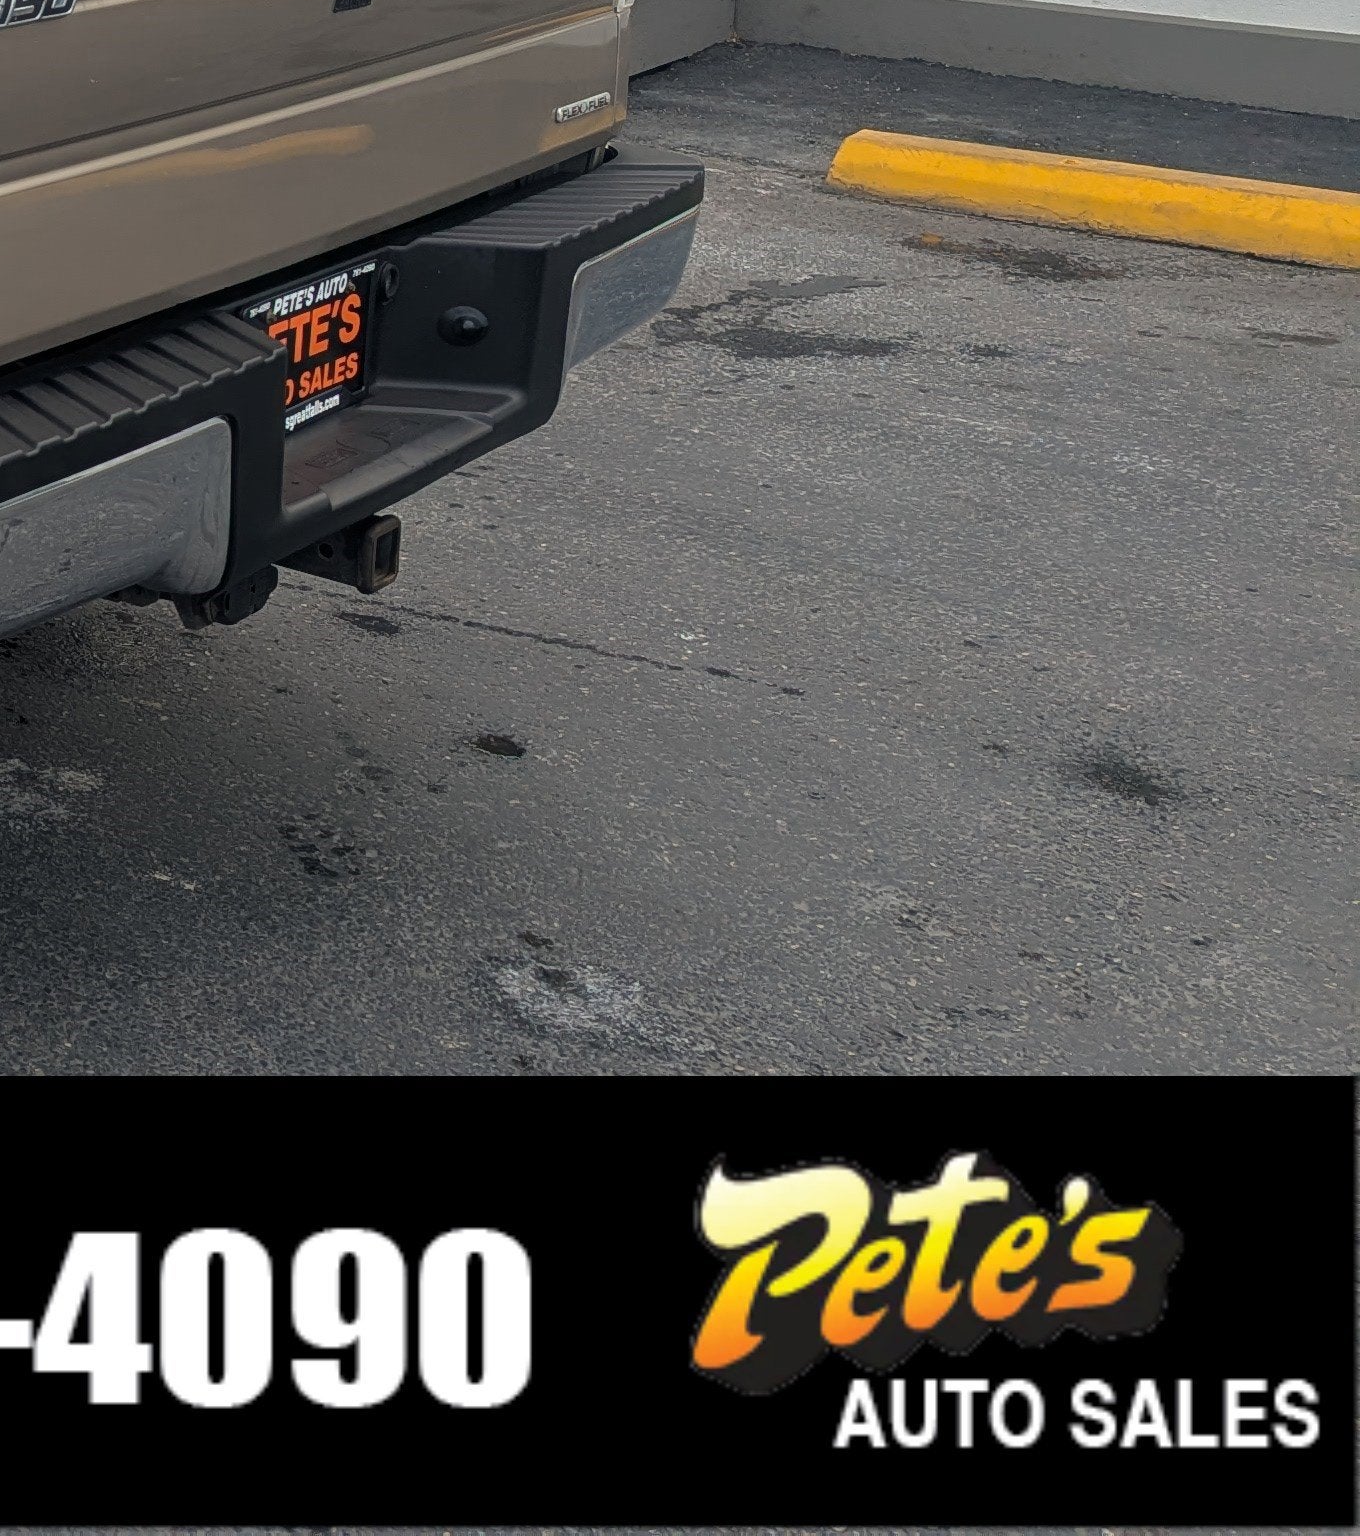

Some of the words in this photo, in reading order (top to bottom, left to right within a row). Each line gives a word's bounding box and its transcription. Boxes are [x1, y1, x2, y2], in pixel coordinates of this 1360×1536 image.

[273, 286, 315, 316] PETE'S
[315, 272, 348, 303] AUTO
[268, 293, 362, 363] ETE'S
[298, 352, 358, 399] SALES
